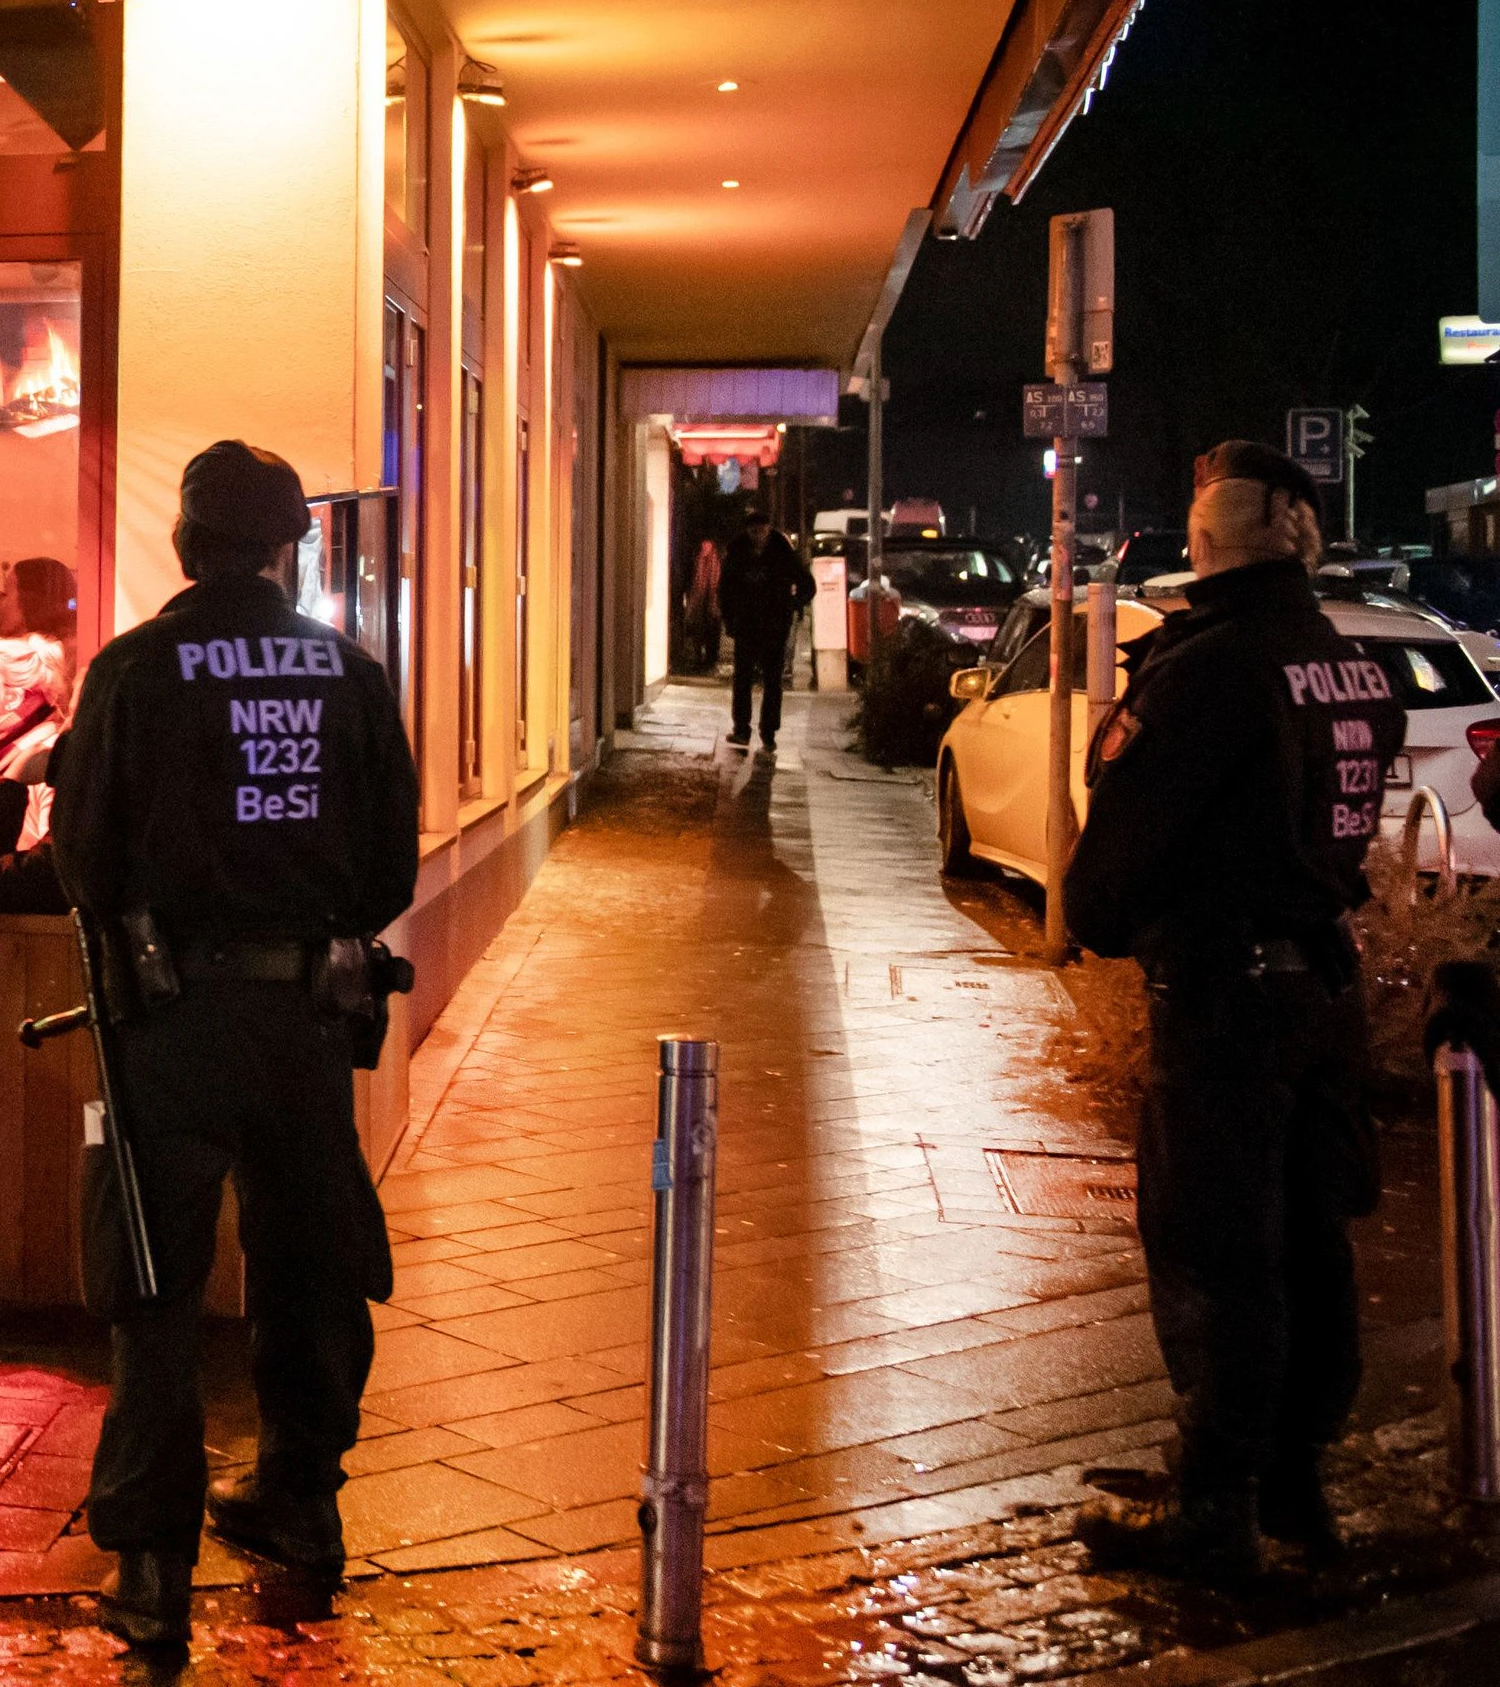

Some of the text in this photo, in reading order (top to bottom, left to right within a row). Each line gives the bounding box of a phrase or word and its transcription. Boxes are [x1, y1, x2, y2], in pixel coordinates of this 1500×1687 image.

[1026, 391, 1043, 403] AS
[1068, 390, 1086, 402] AS
[1300, 416, 1330, 455] P
[177, 637, 344, 681] POLIZEI
[1284, 661, 1393, 705] POLIZEI
[230, 699, 323, 734] NRW
[241, 738, 321, 775] 1232
[236, 784, 318, 821] BeSi
